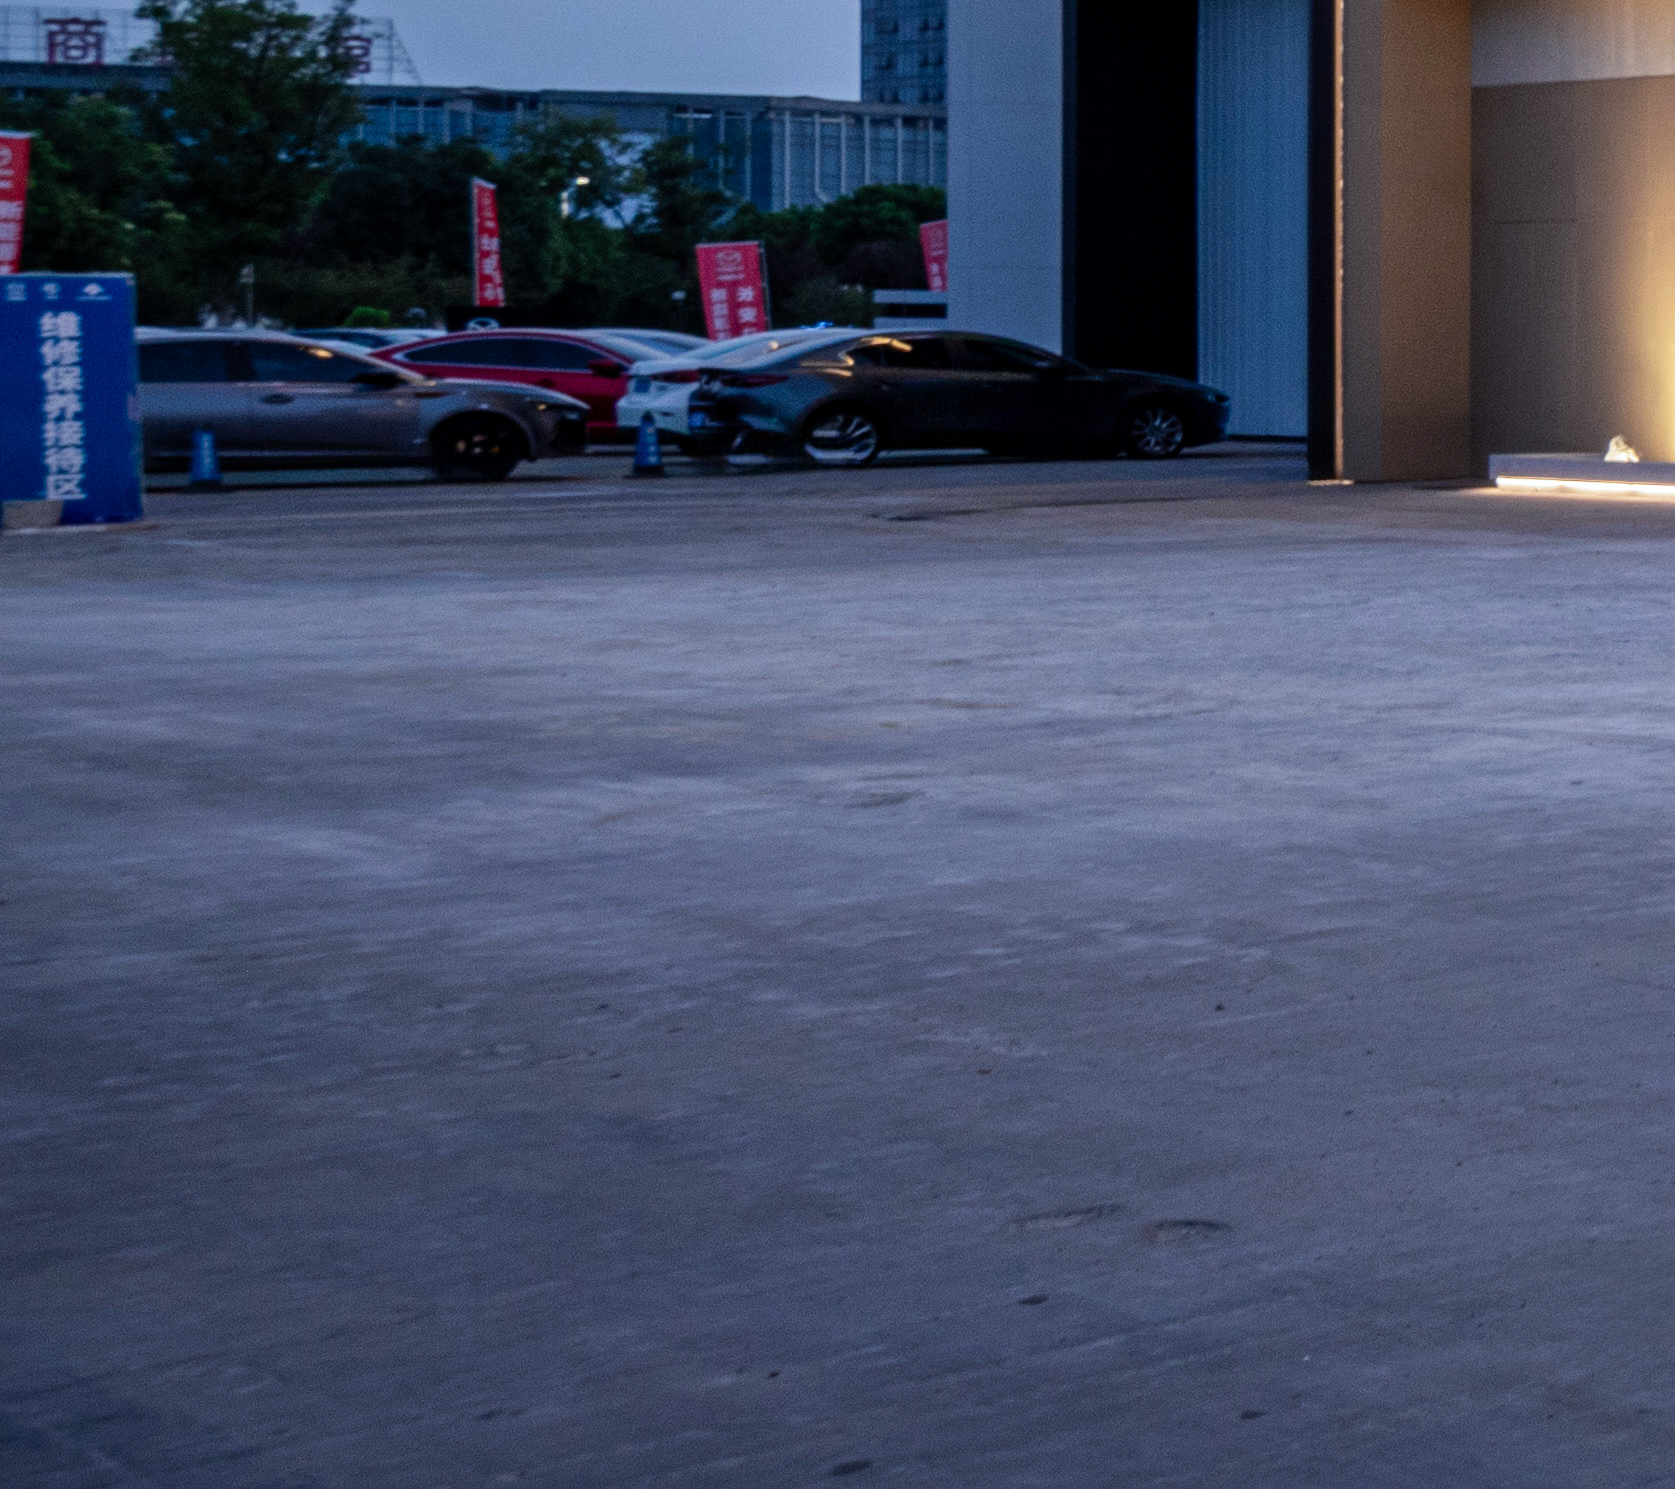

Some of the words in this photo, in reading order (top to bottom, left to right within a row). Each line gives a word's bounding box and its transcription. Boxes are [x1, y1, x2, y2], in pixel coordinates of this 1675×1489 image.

[39, 310, 87, 500] 维修保养接待区
